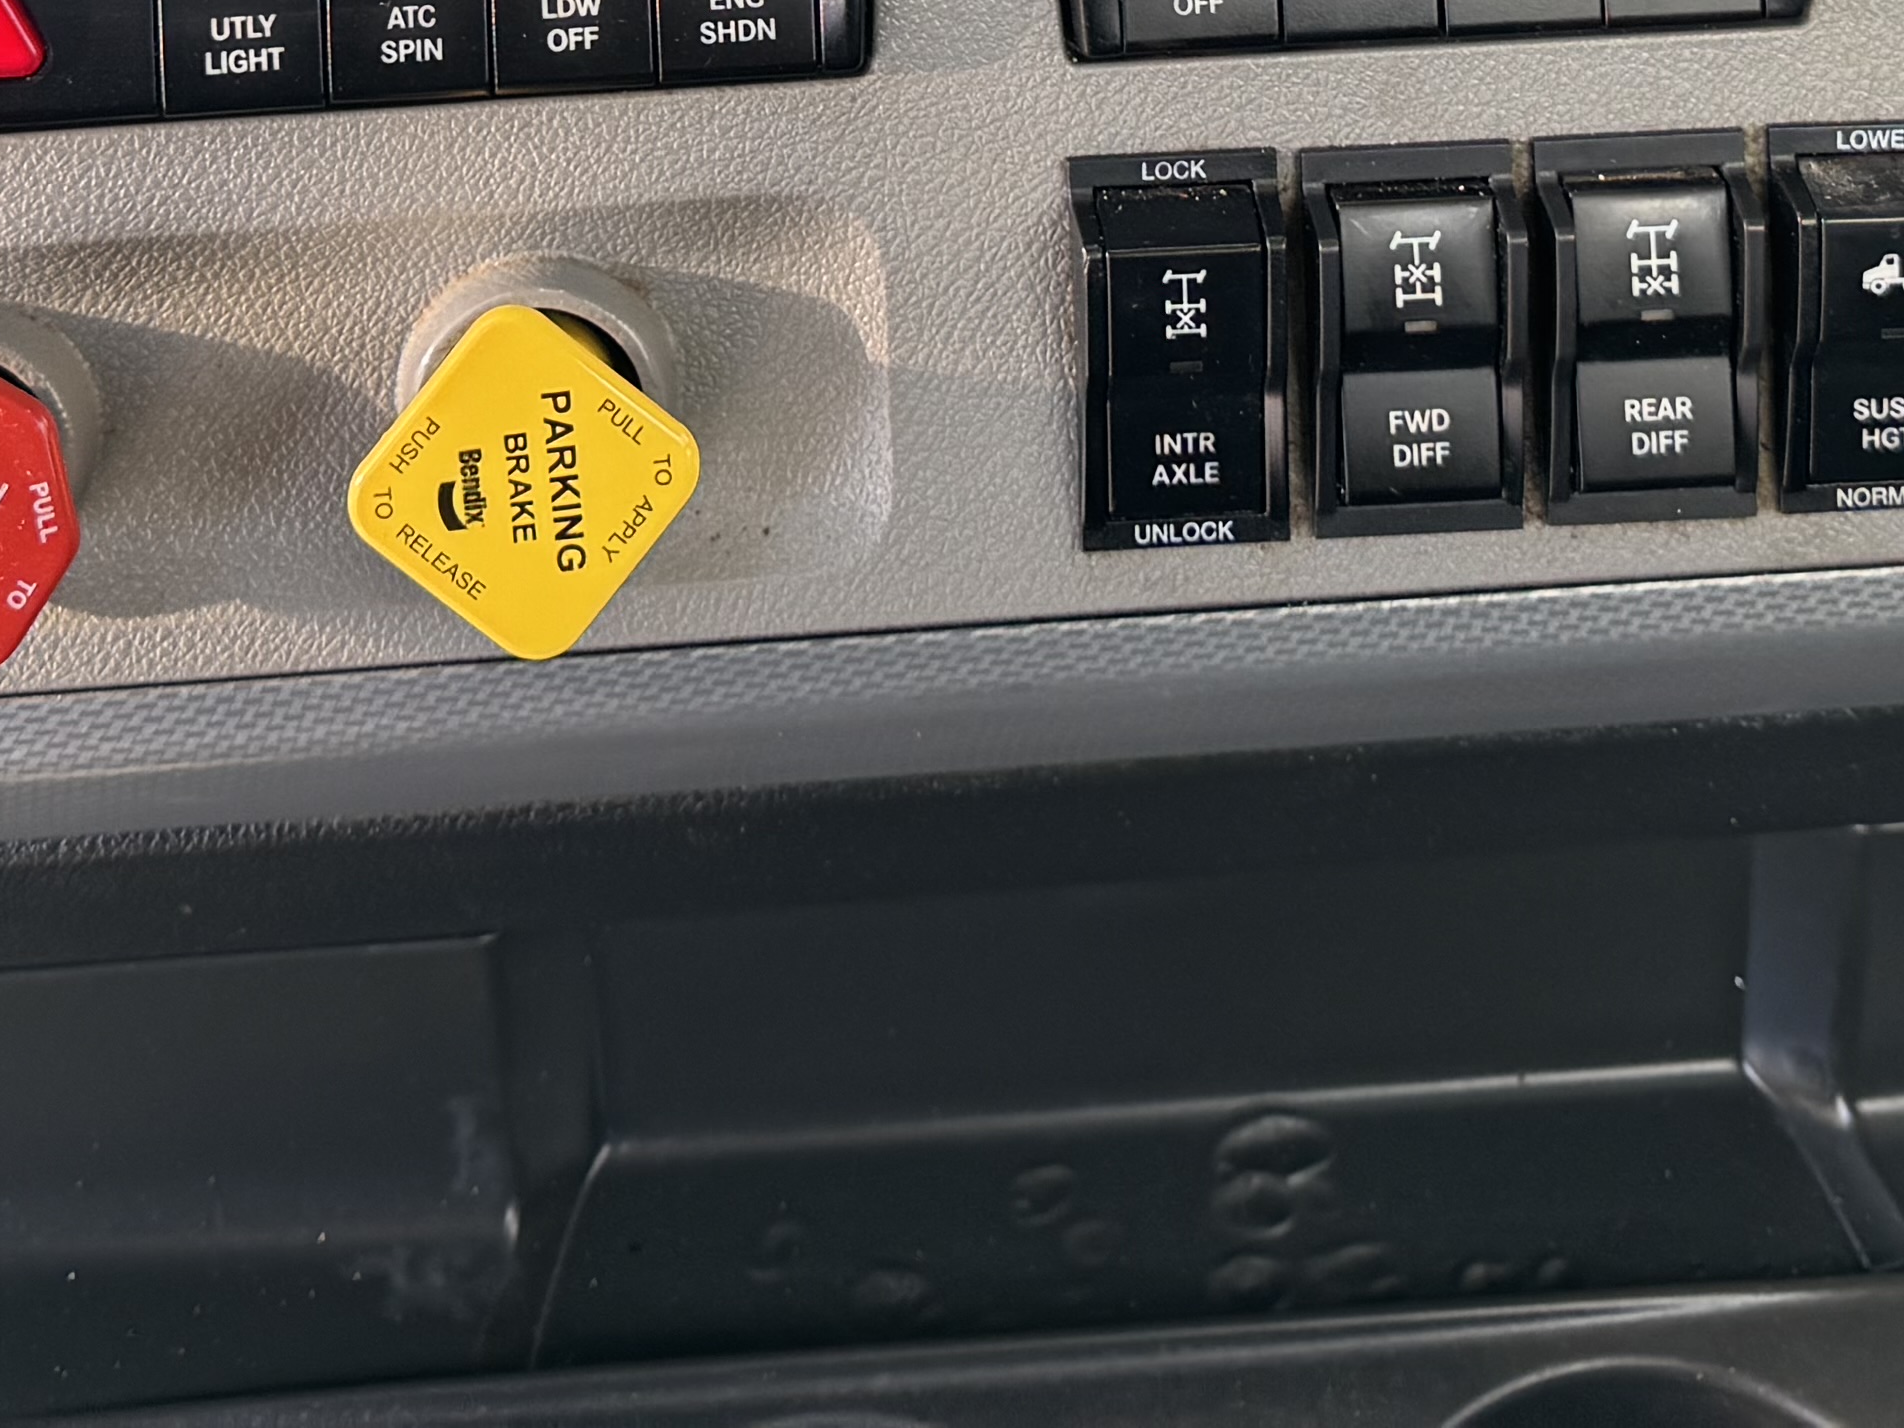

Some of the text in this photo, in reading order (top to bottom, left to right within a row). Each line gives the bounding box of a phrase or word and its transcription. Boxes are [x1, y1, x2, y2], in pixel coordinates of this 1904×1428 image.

[210, 13, 277, 42] UTLY
[386, 5, 437, 30] ATC
[699, 16, 777, 46] SHDN
[380, 39, 444, 65] SPIN
[547, 26, 600, 54] OFF
[204, 46, 285, 76] LIGHT
[1141, 159, 1207, 180] LOCK
[1388, 409, 1450, 435] FWD
[1624, 397, 1693, 423] REAR
[1154, 432, 1216, 456] INTR
[1392, 443, 1450, 468] DIFF
[1630, 430, 1689, 456] DIFF
[458, 448, 487, 528] Bendix
[503, 432, 538, 544] BRAKE
[540, 389, 587, 574] PARKING
[597, 398, 673, 564] PULL TO APPLY
[1151, 462, 1221, 487] AXLE
[29, 481, 59, 544] PULL
[372, 416, 487, 601] PUSH TO RELEASE
[1134, 520, 1234, 543] UNLOCK
[6, 578, 37, 611] TO
